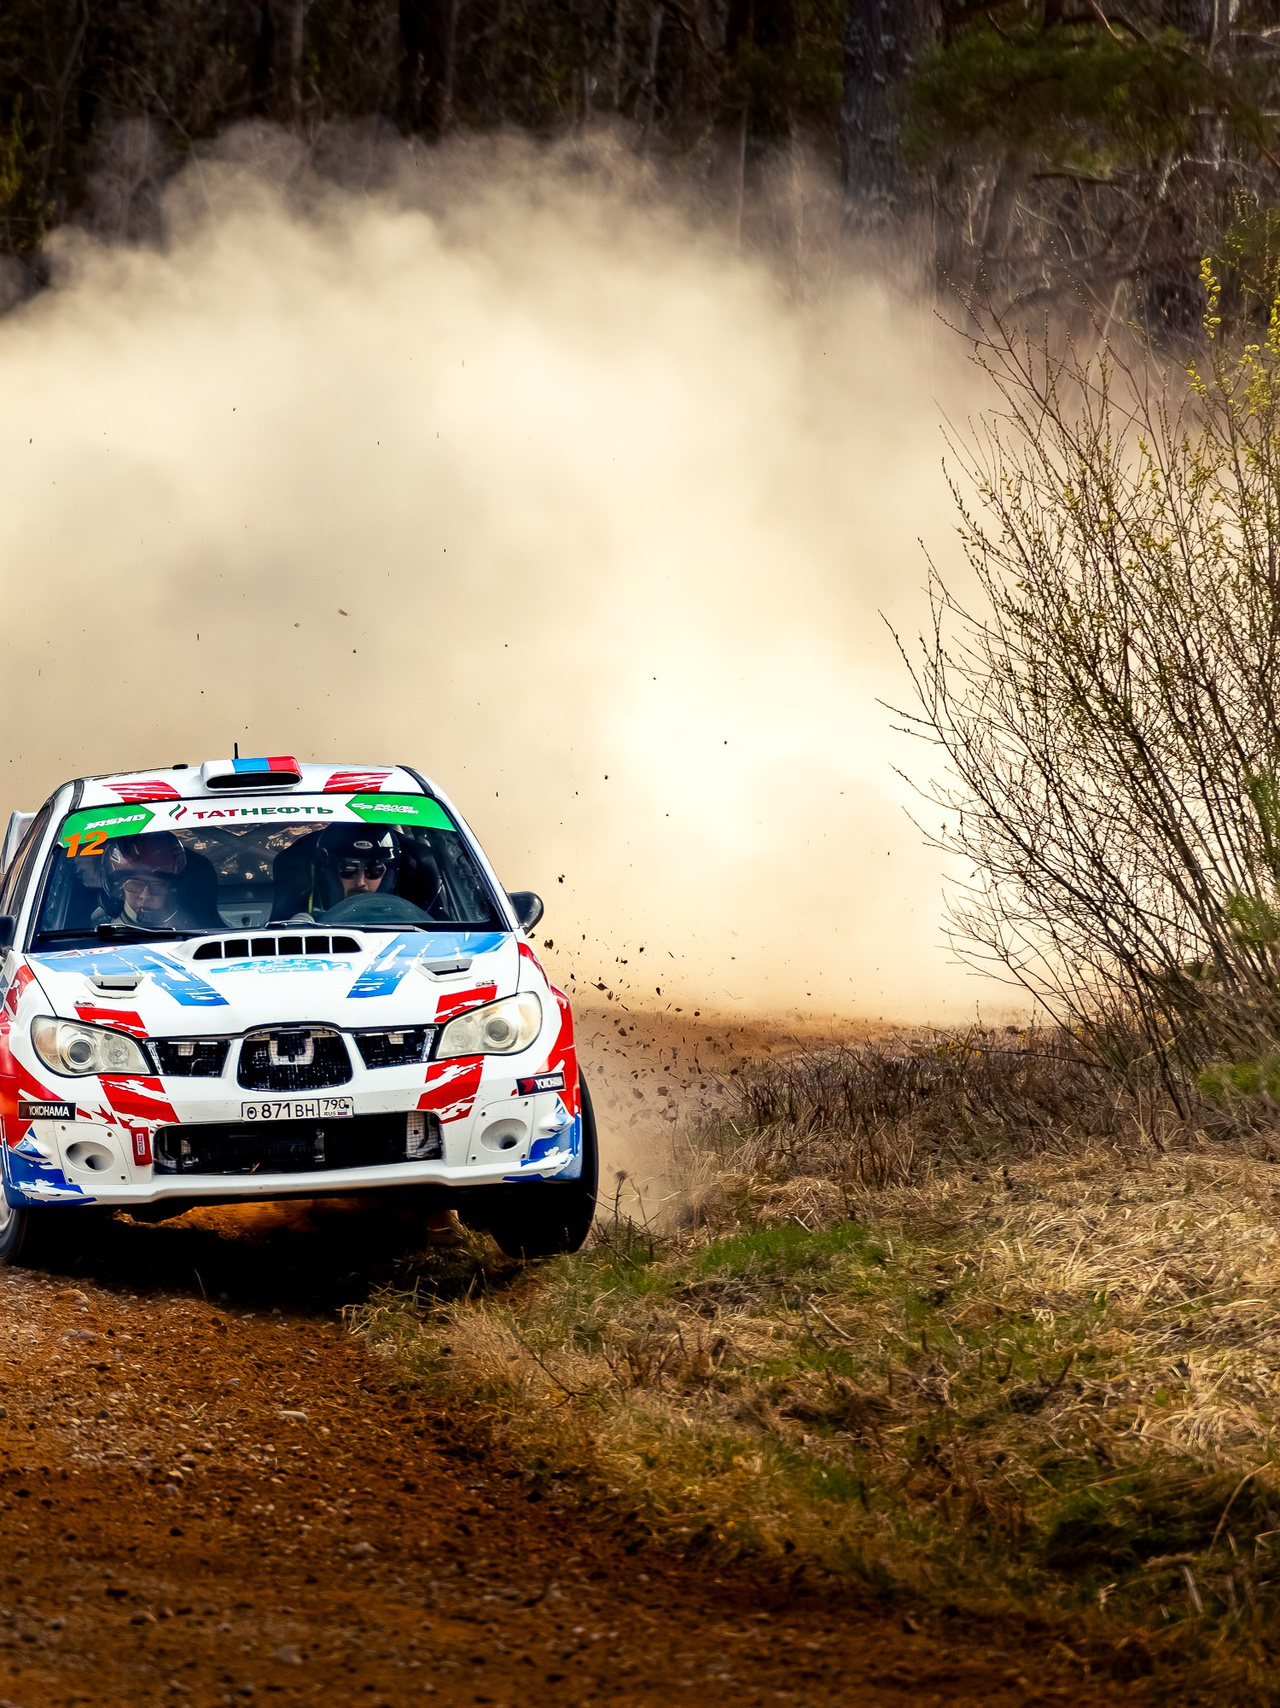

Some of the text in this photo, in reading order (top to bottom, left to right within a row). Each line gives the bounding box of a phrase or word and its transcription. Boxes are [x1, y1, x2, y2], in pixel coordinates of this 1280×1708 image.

[193, 806, 334, 819] ТАТНЕФТЬ
[64, 830, 108, 857] 12
[317, 961, 350, 971] 12
[534, 1076, 564, 1090] YOKOH
[28, 1105, 70, 1117] YOKOHAMA
